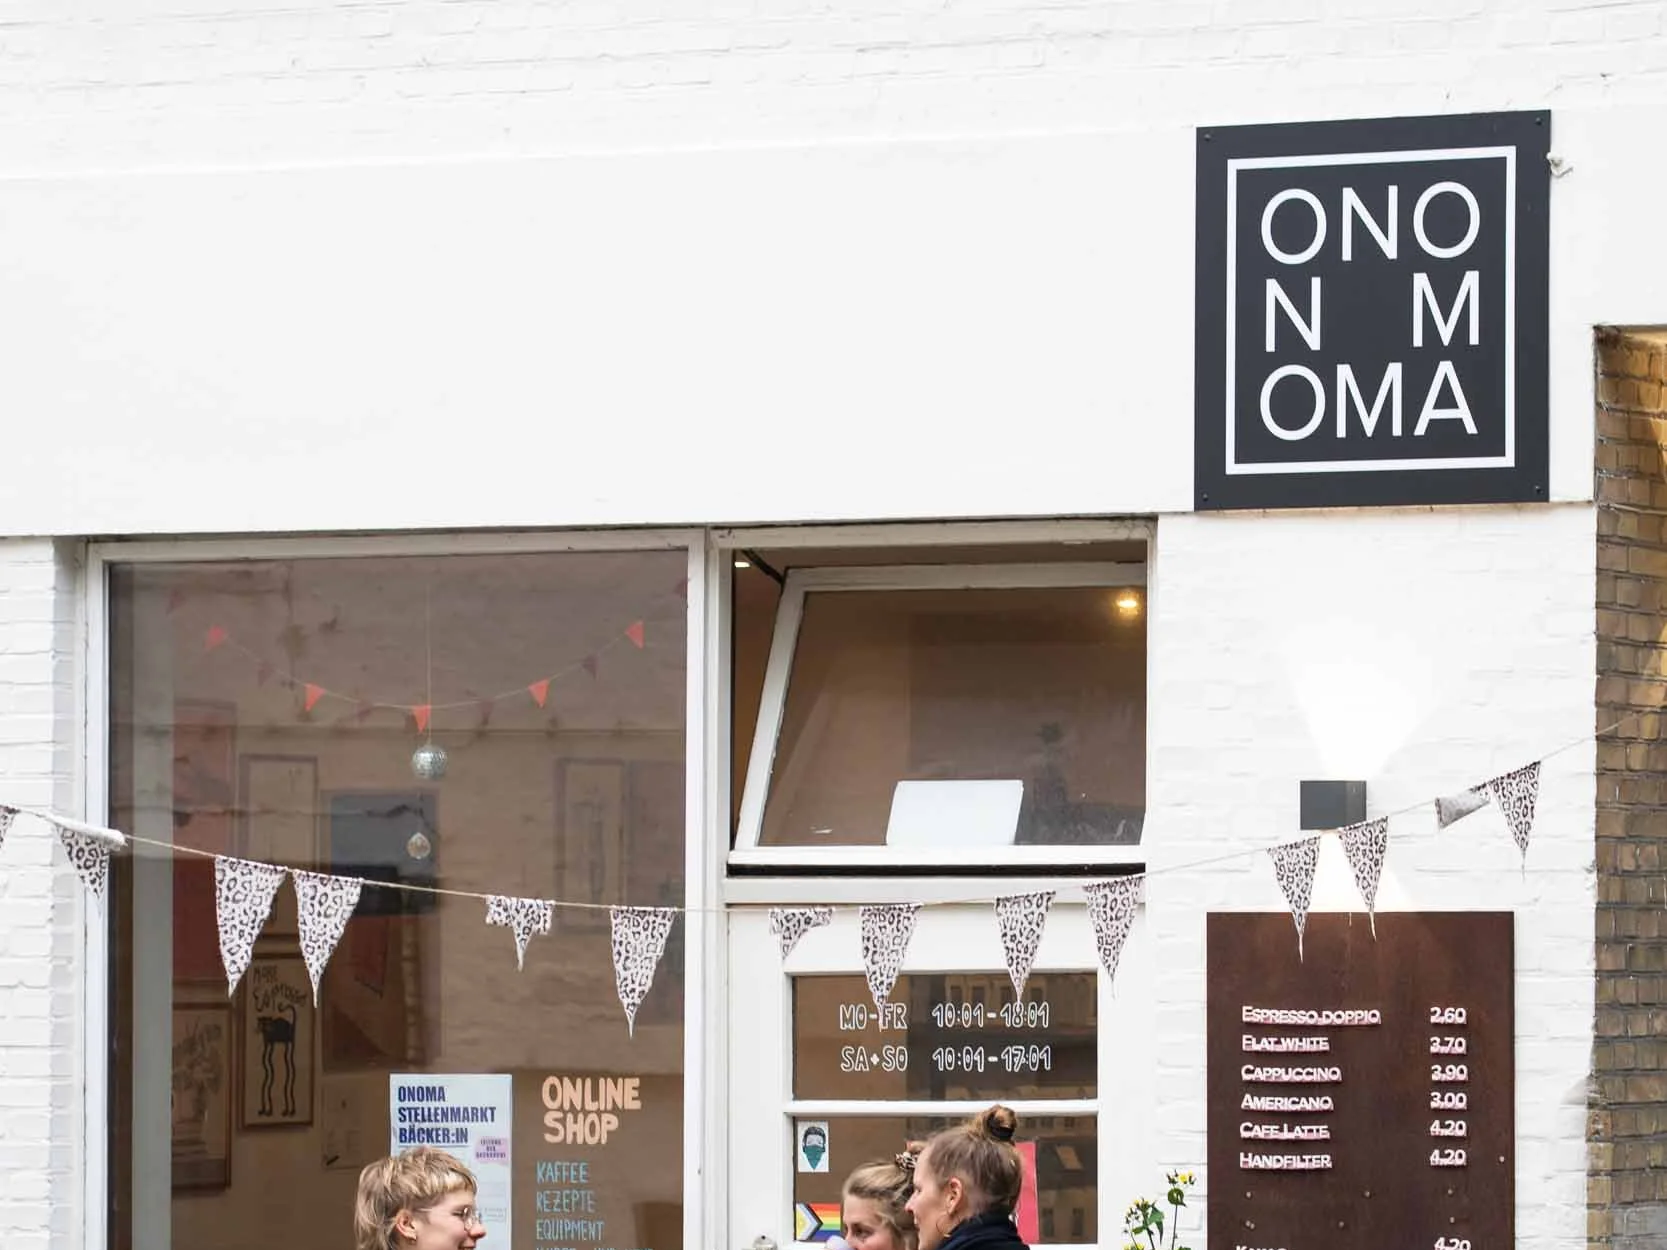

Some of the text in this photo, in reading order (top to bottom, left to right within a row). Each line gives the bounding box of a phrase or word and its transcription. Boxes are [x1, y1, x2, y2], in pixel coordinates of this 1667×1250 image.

[1260, 181, 1481, 265] ONO
[1265, 270, 1480, 353] N M
[1259, 360, 1479, 441] OMA
[1241, 1064, 1343, 1083] CAPPUCCINO
[397, 1085, 447, 1103] ONOMA
[541, 1075, 642, 1111] ONLINE
[1240, 1093, 1334, 1112] AMERICANO
[397, 1106, 497, 1124] STELLENMARKT
[398, 1124, 469, 1144] BÄCKER:IN
[543, 1110, 620, 1145] SHOP
[535, 1160, 589, 1184] KAFFEE
[1239, 1152, 1333, 1170] HANDFILTER
[535, 1189, 597, 1213] REZEPTE
[535, 1218, 606, 1241] EQUIPMENT
